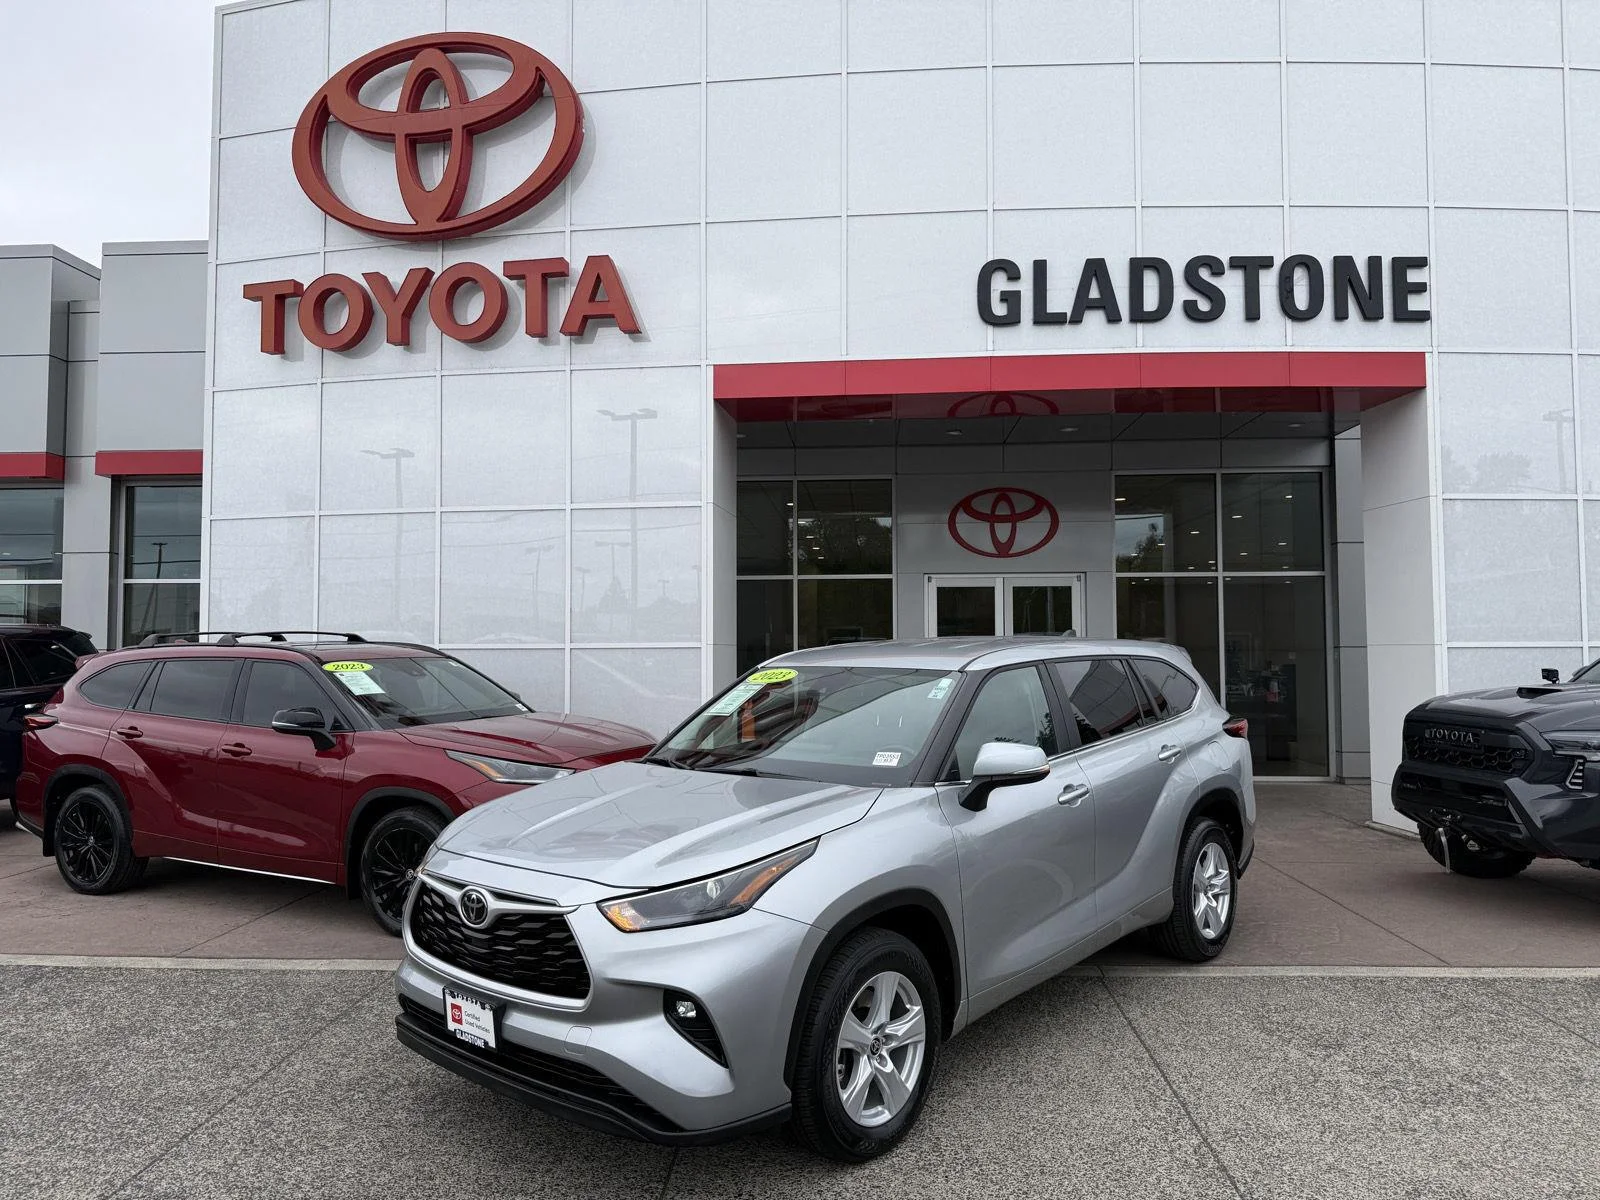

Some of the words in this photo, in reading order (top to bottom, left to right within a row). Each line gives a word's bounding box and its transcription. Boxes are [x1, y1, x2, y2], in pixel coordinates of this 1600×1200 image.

[977, 254, 1432, 326] GLADSTONE
[243, 254, 642, 356] TOYOTA
[333, 663, 365, 671] 2023
[1429, 727, 1475, 743] TOYOTA
[456, 1029, 485, 1048] GLADSTONE
